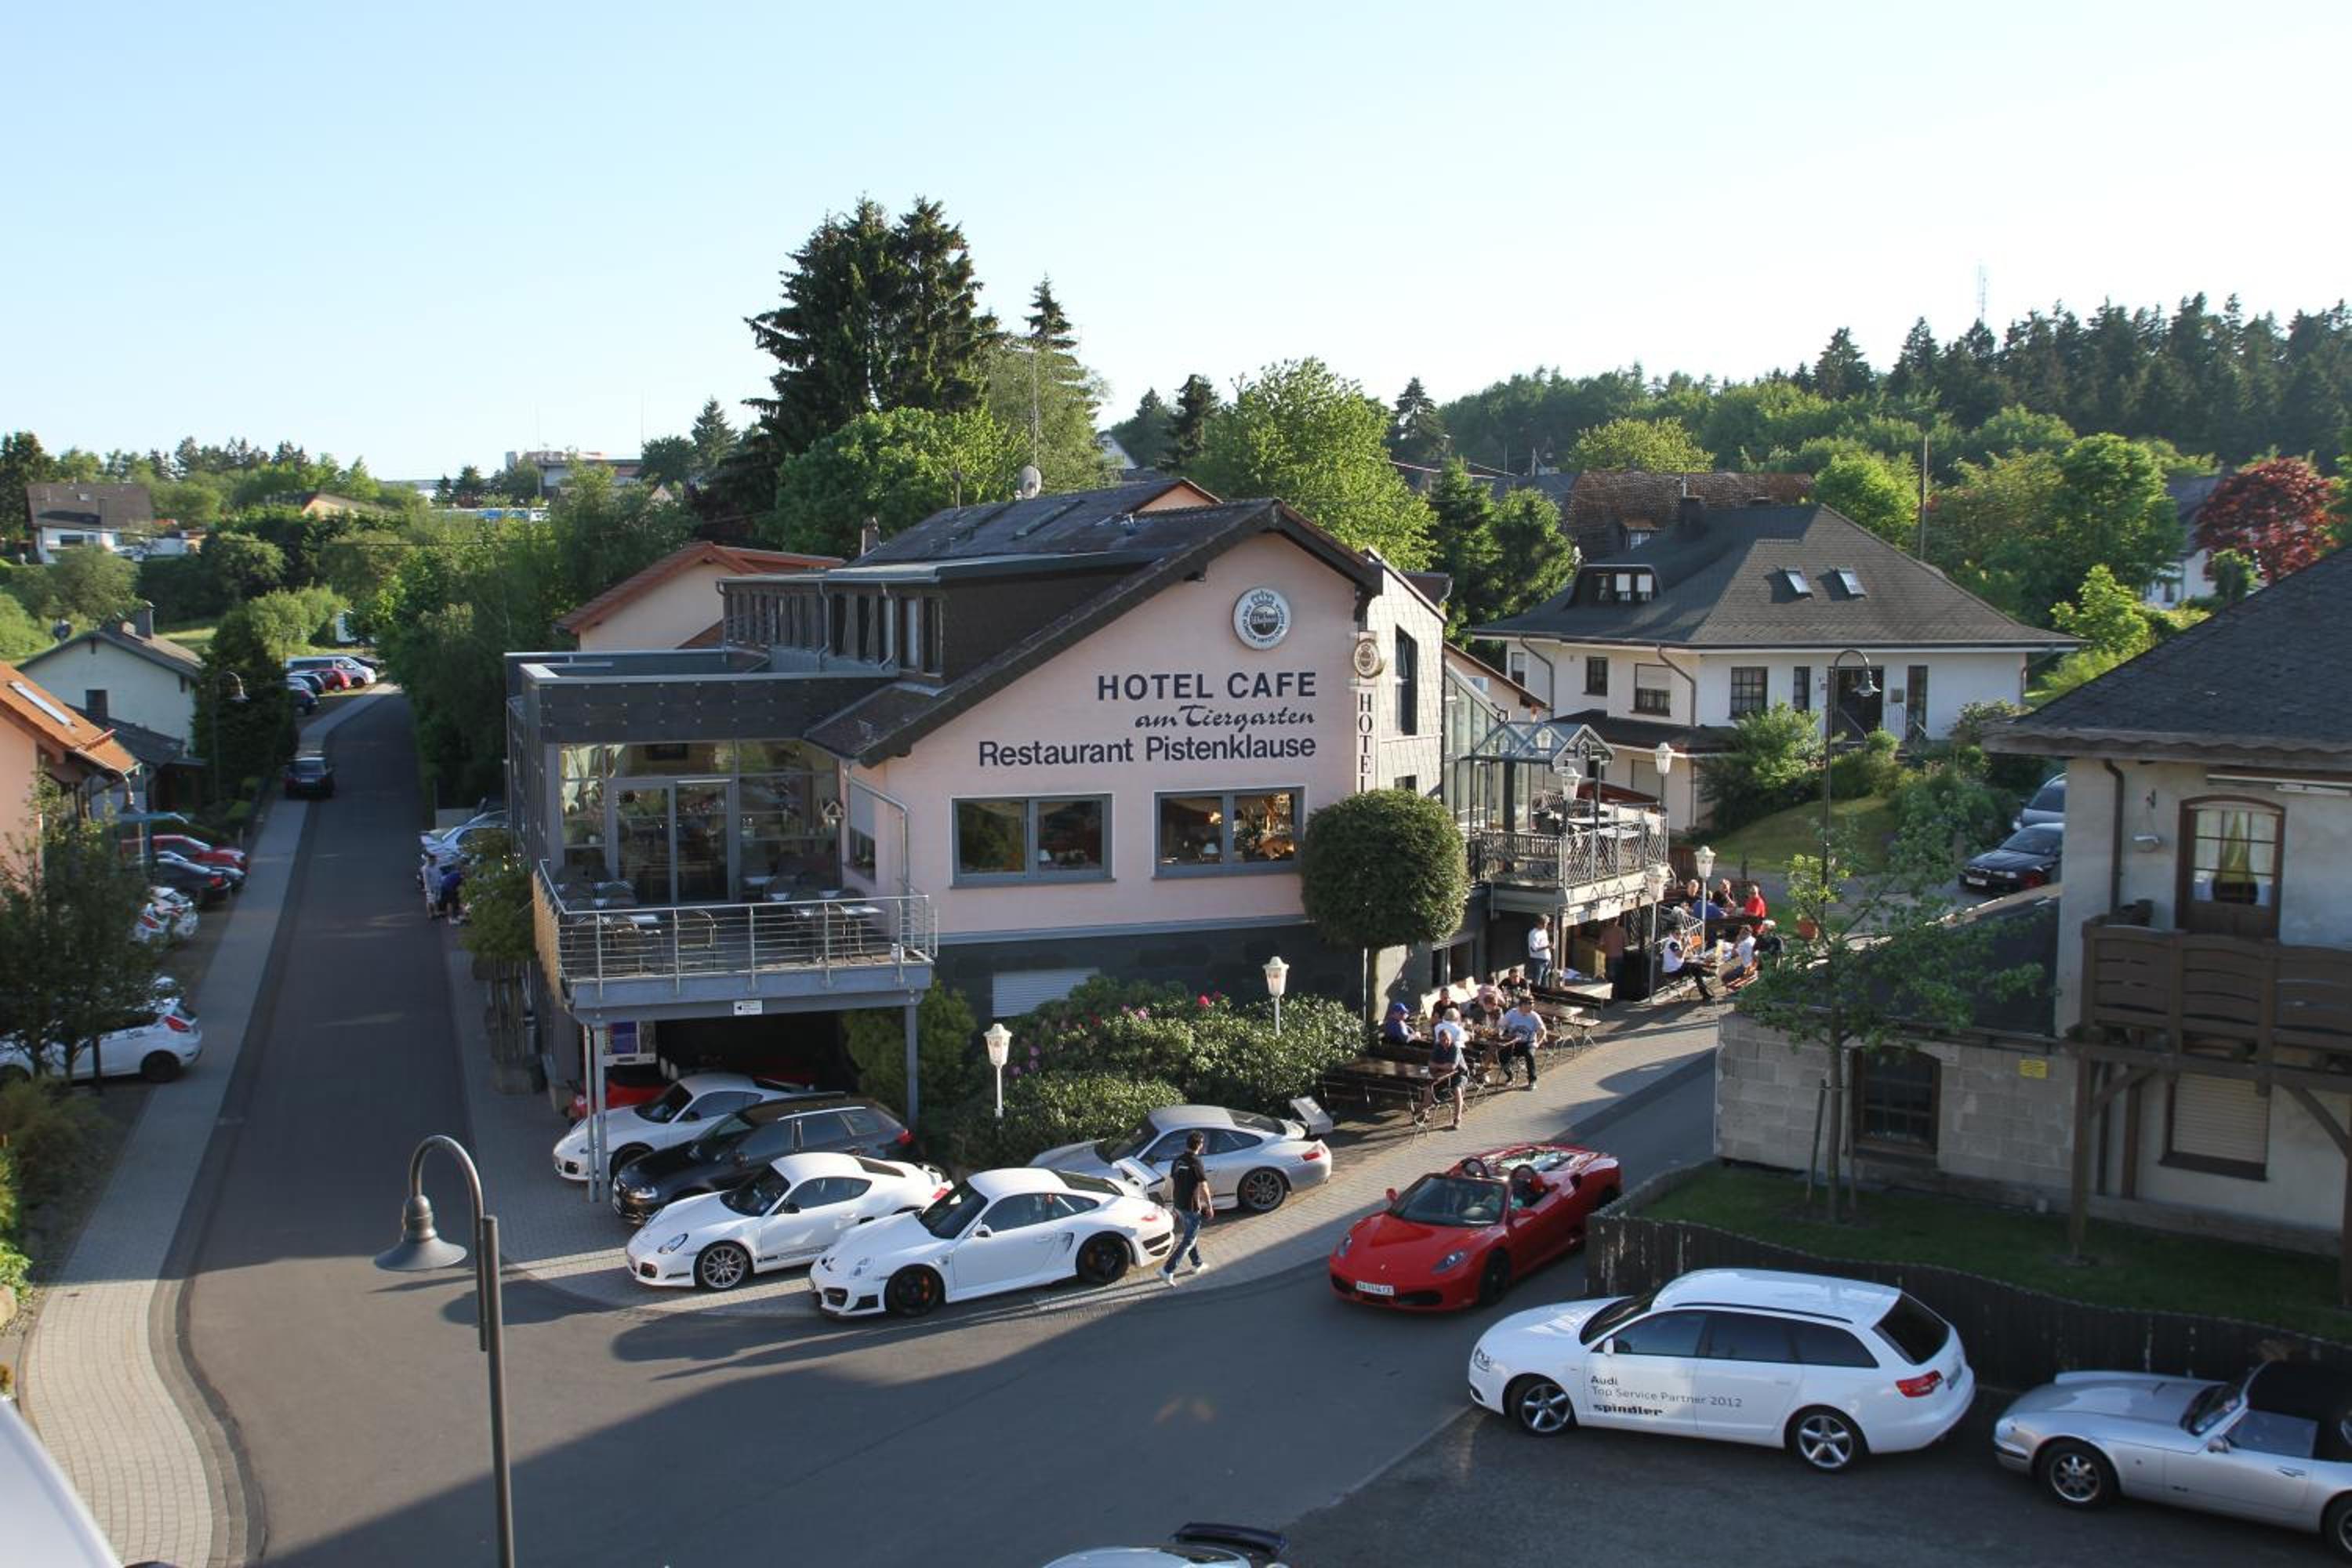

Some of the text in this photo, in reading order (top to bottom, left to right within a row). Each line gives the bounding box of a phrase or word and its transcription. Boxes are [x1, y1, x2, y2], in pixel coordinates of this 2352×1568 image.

[1098, 672, 1316, 702] HOTEL CAFE
[1134, 704, 1316, 733] am Tiergarten
[978, 732, 1316, 768] Restaurant Pistenklause
[1591, 1375, 1618, 1385] Audi
[1592, 1385, 1743, 1408] Top Service Partner 2012
[1592, 1403, 1664, 1417] spindler
